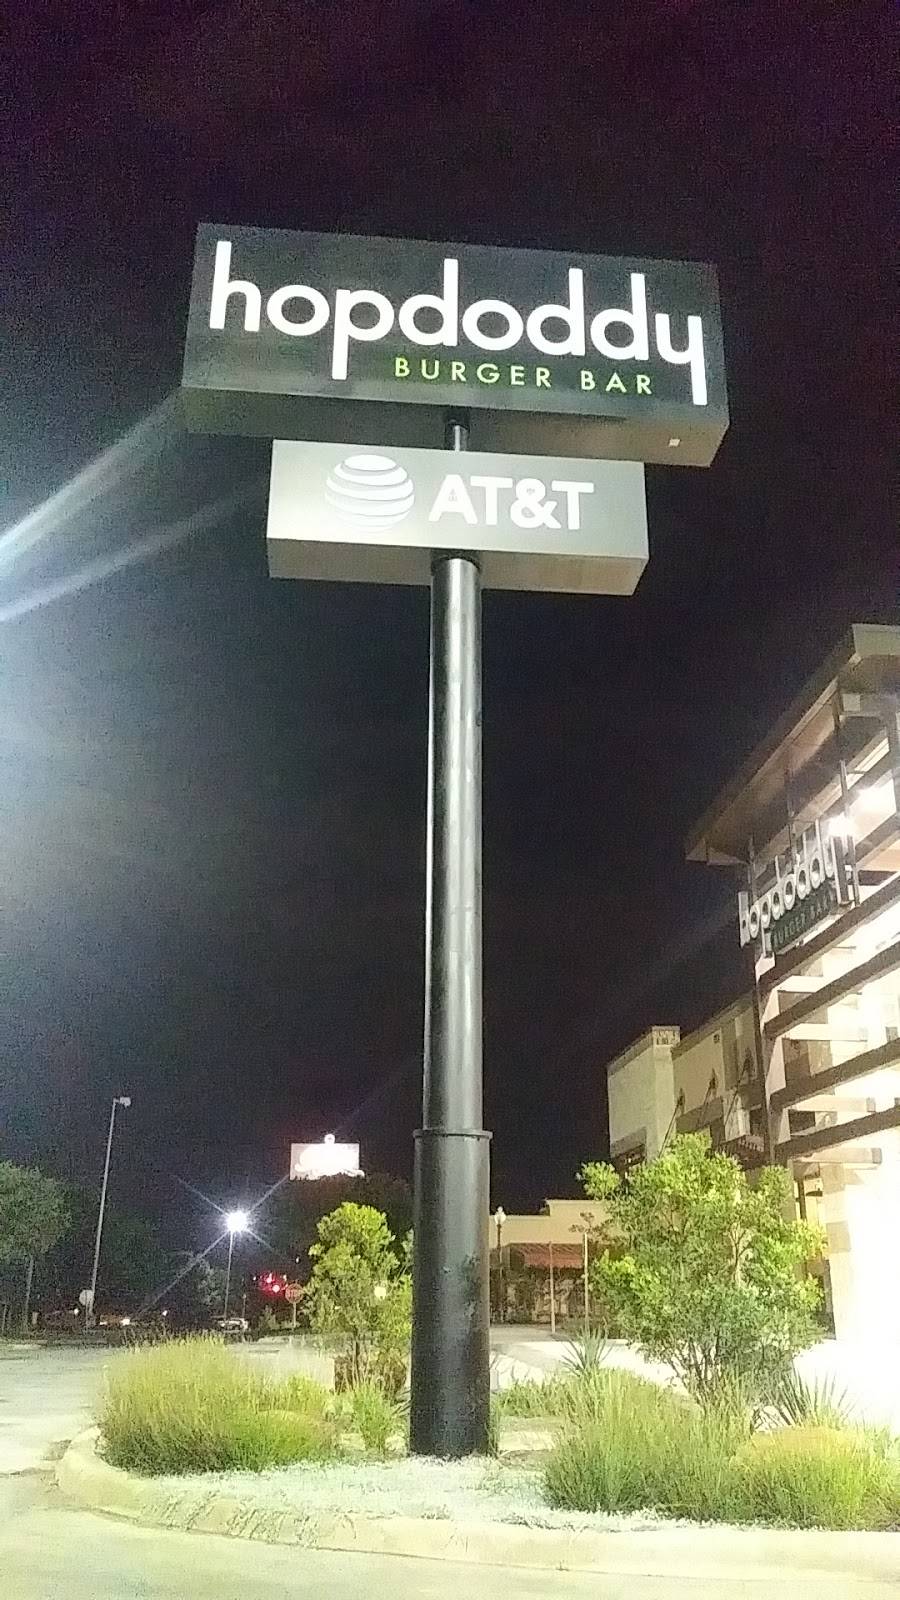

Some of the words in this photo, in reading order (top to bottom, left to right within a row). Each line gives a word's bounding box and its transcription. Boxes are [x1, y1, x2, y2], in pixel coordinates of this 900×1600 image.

[209, 240, 707, 406] hopdoddy
[394, 356, 552, 388] BURGER
[580, 370, 653, 395] BAR
[428, 474, 595, 531] AT&T
[738, 819, 848, 957] hopdoddy
